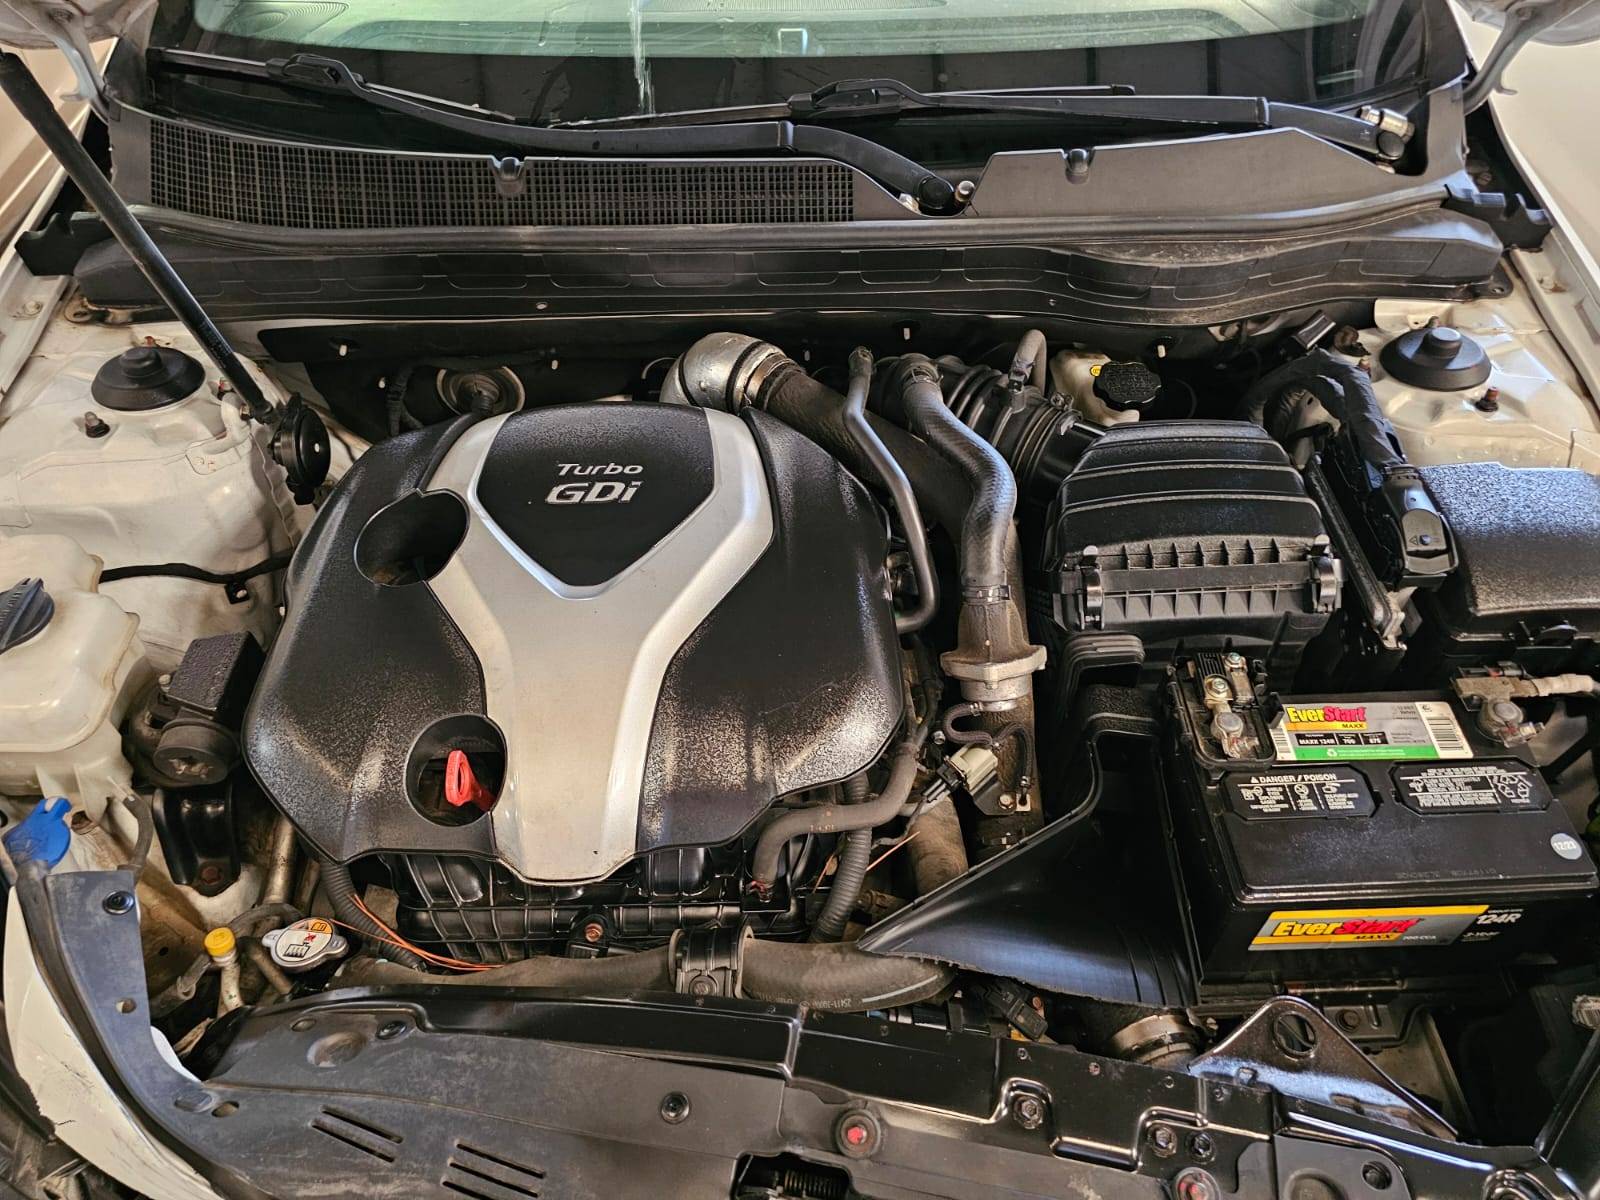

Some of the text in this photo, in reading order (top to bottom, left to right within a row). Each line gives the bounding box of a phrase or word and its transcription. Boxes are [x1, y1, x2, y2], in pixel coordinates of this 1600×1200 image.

[557, 462, 644, 475] Turbo
[546, 481, 643, 504] GDi
[1286, 706, 1367, 723] EverStart
[1259, 775, 1296, 783] DANGER
[1304, 773, 1337, 782] POISON
[1476, 913, 1522, 925] 124R
[1272, 918, 1421, 936] EverStart
